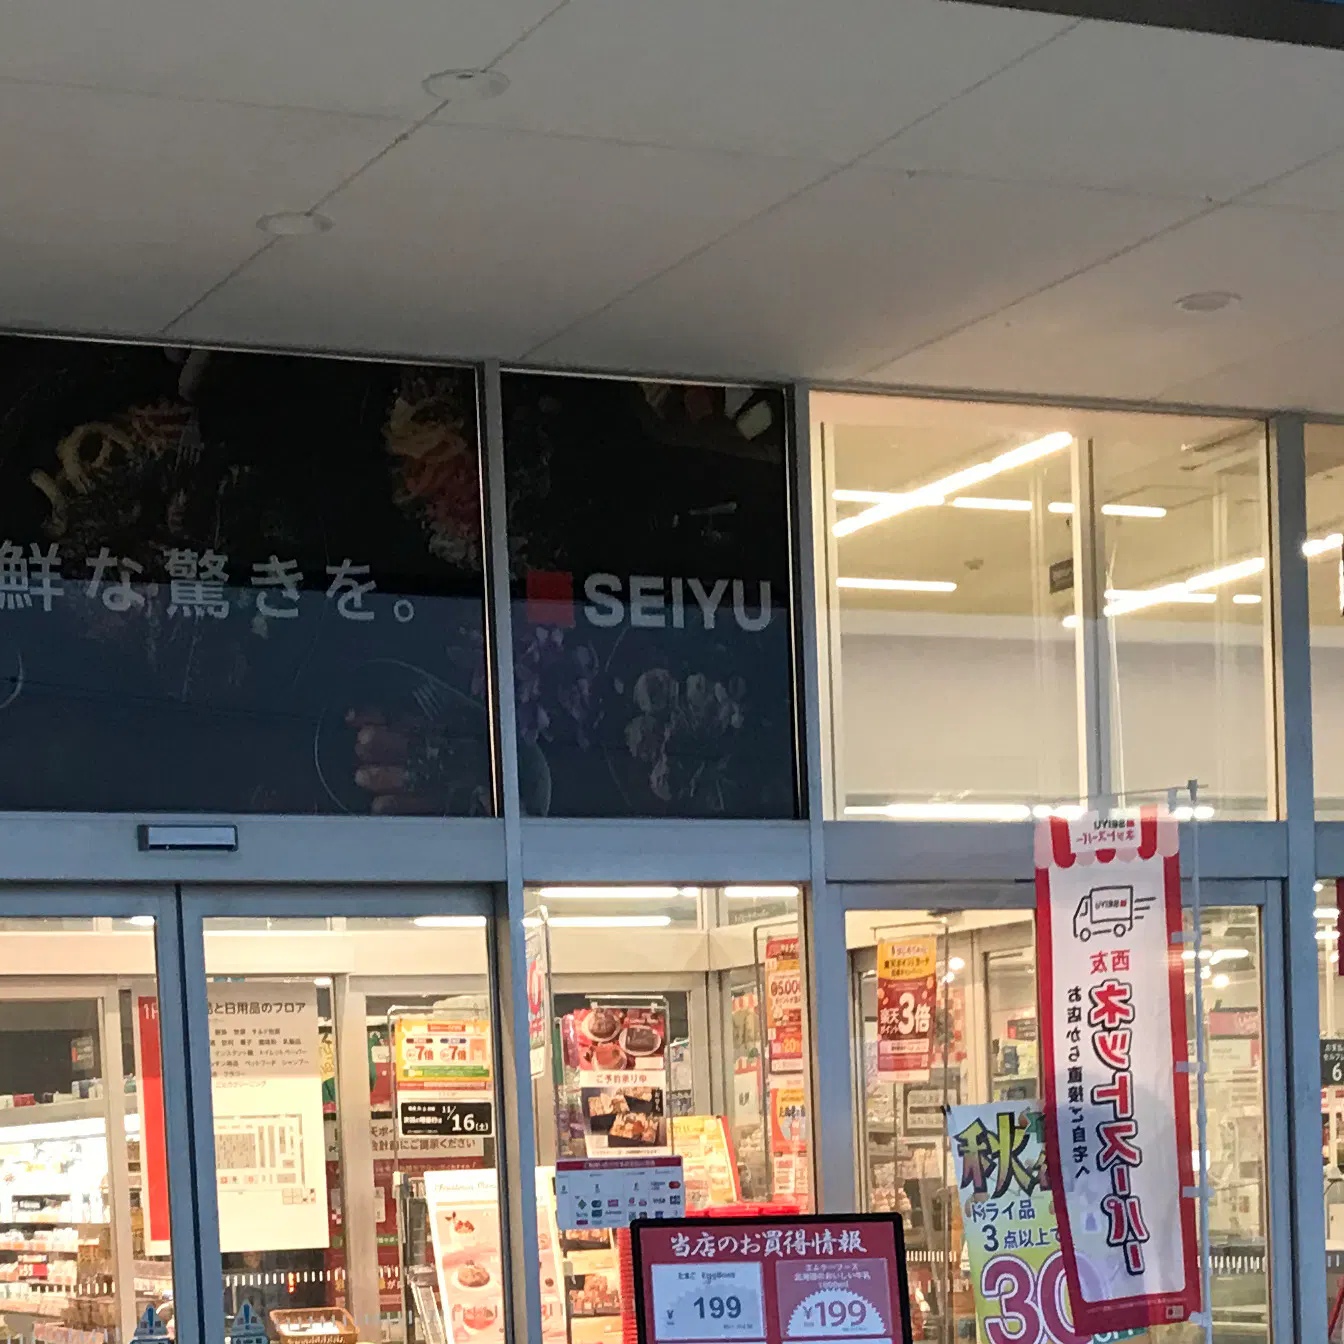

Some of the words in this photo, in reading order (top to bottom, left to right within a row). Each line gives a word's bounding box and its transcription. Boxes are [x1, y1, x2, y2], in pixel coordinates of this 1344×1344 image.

[583, 572, 772, 631] SEIYU
[1331, 1062, 1343, 1082] 6
[972, 1198, 1036, 1223] ドライ品
[671, 1229, 868, 1258] 当店のお買得情報
[693, 1295, 742, 1319] 199
